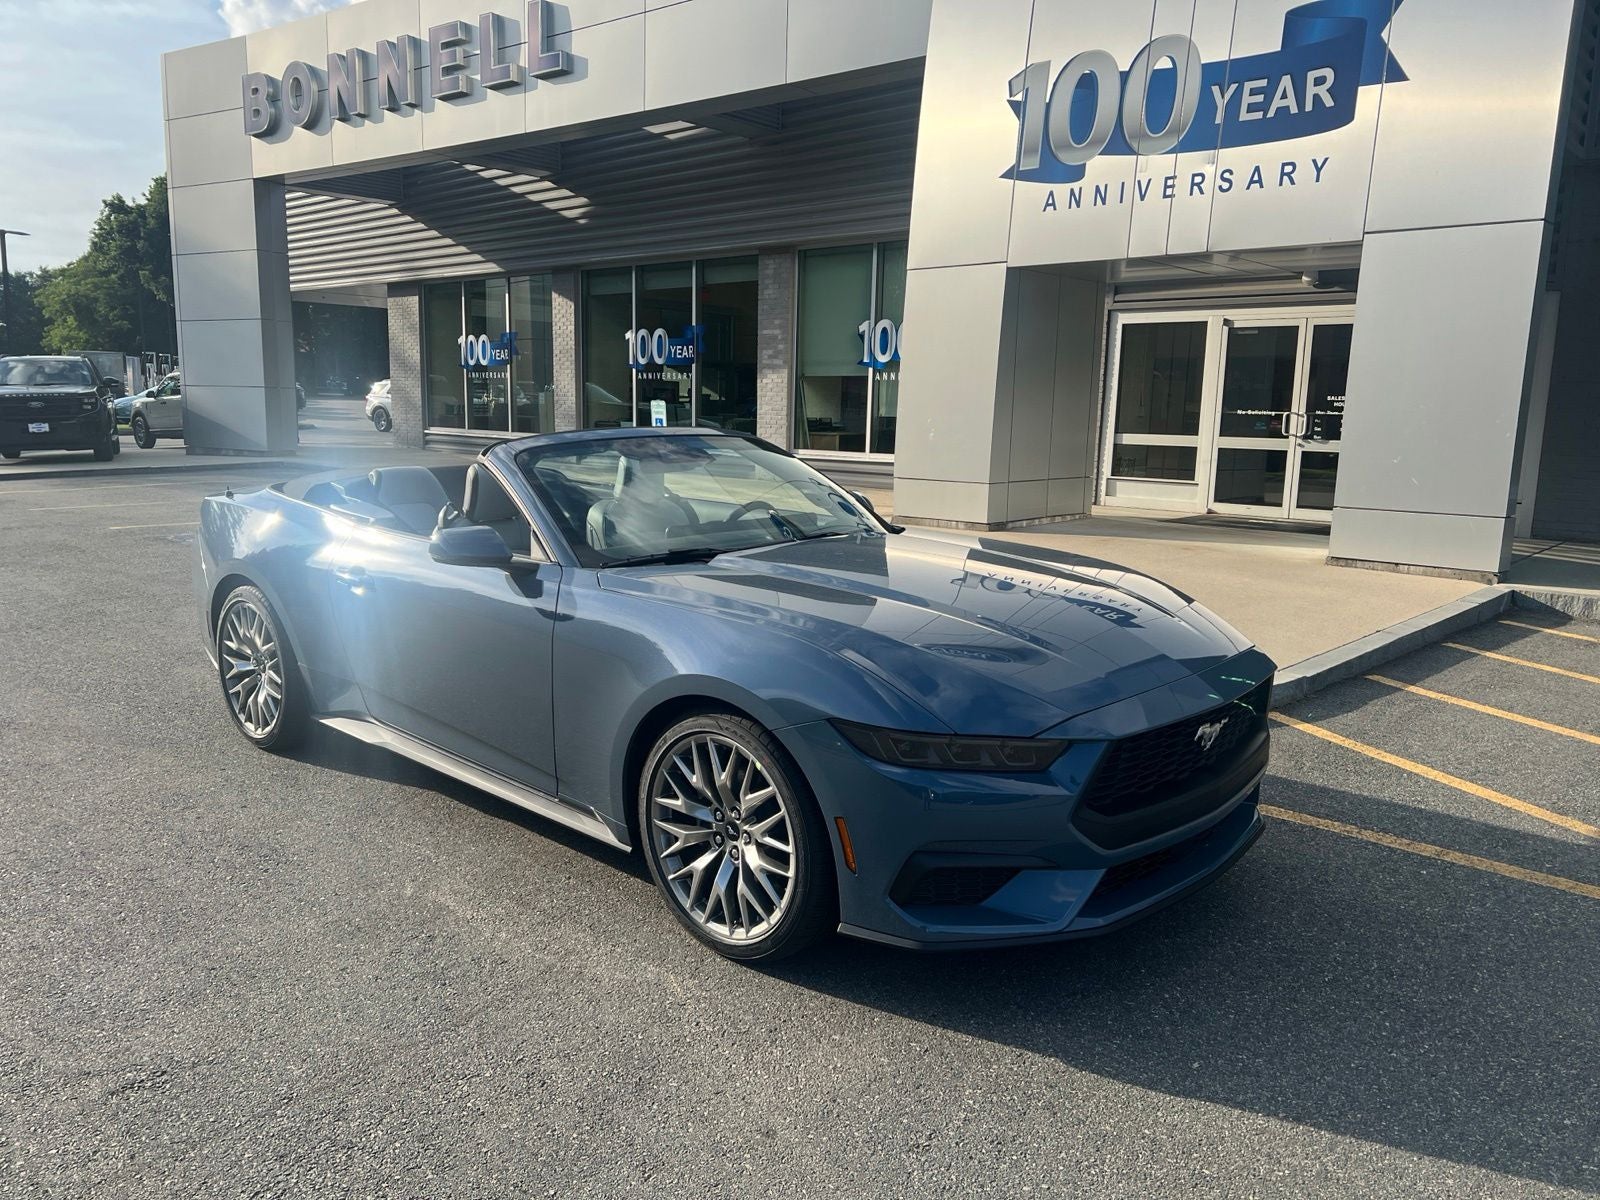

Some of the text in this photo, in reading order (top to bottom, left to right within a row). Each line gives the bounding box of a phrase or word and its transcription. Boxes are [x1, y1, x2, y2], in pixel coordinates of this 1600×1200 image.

[243, 0, 572, 136] BONNELL
[1008, 34, 1335, 170] 100 YEAR
[1042, 156, 1330, 212] ANNIVERSARY
[457, 333, 509, 366] 100 YEAR
[624, 327, 694, 365] 100 YEAR
[858, 318, 904, 363] 10
[468, 371, 509, 379] ANNIVERSARY
[637, 372, 693, 380] ANNIVERSARY
